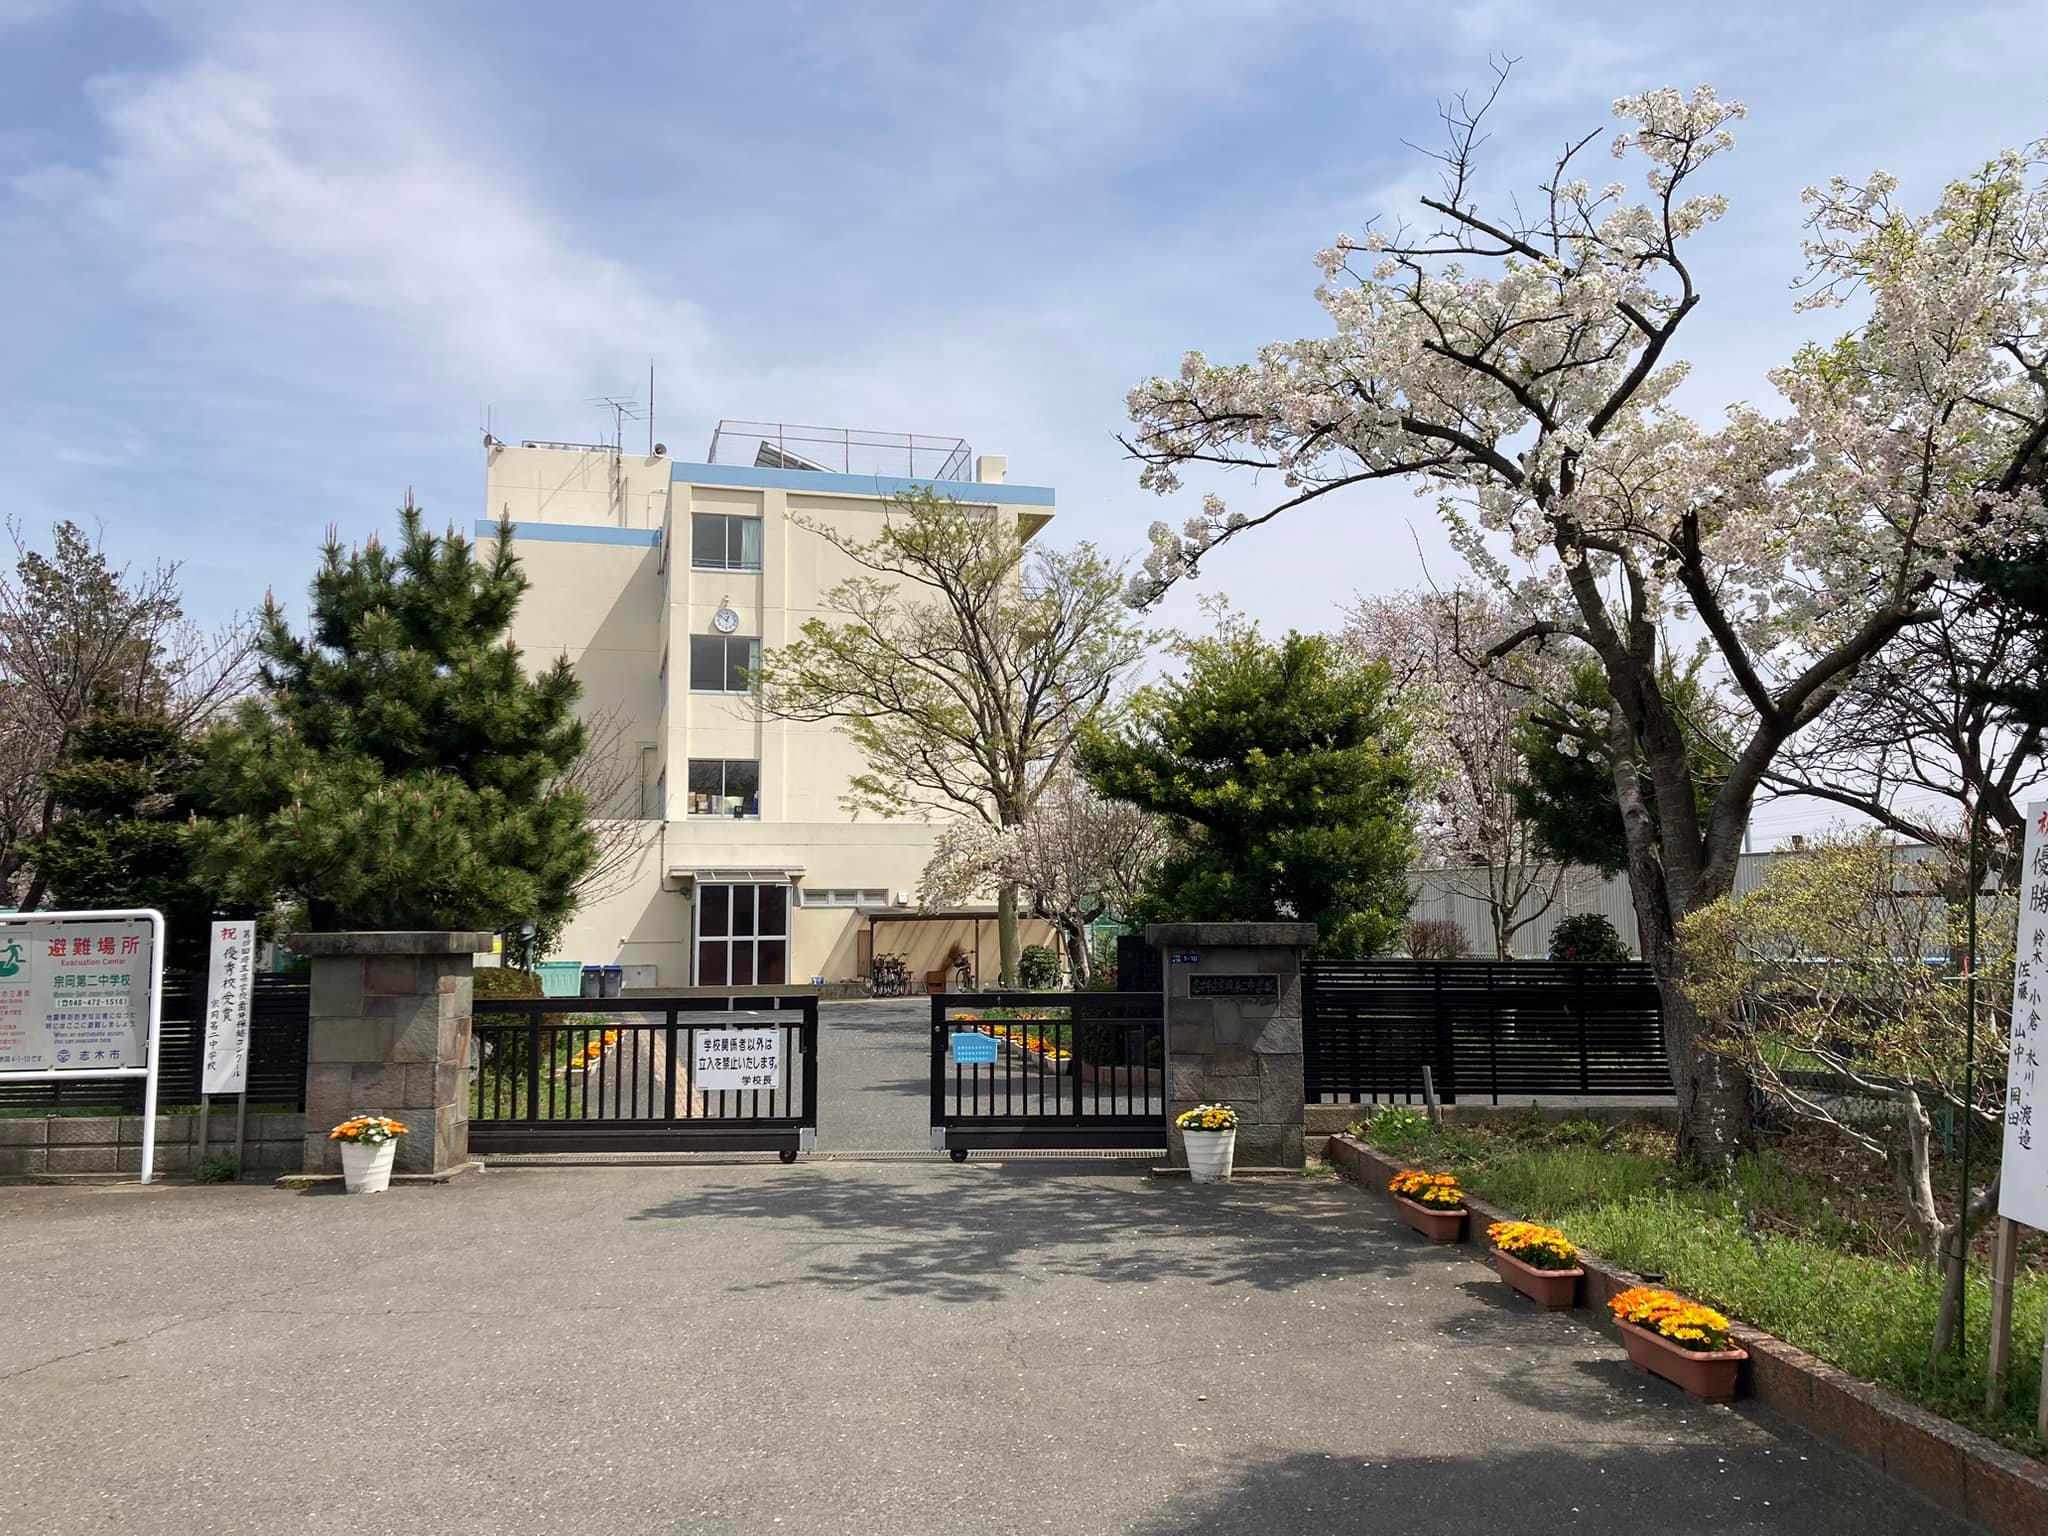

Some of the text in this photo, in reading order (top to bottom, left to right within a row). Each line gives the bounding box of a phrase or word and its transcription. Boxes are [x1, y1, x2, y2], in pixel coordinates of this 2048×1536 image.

[220, 927, 237, 940] 祝
[47, 936, 140, 957] 避難場所
[61, 959, 100, 967] Evacuation
[54, 974, 130, 988] 宗岡第二中学校
[221, 945, 239, 1022] 優秀校受賞
[703, 1037, 773, 1052] 学校関係者以外は
[79, 1049, 121, 1061] 志木市
[698, 1056, 778, 1070] 立入を禁止いたします。
[741, 1075, 772, 1085] 学校長
